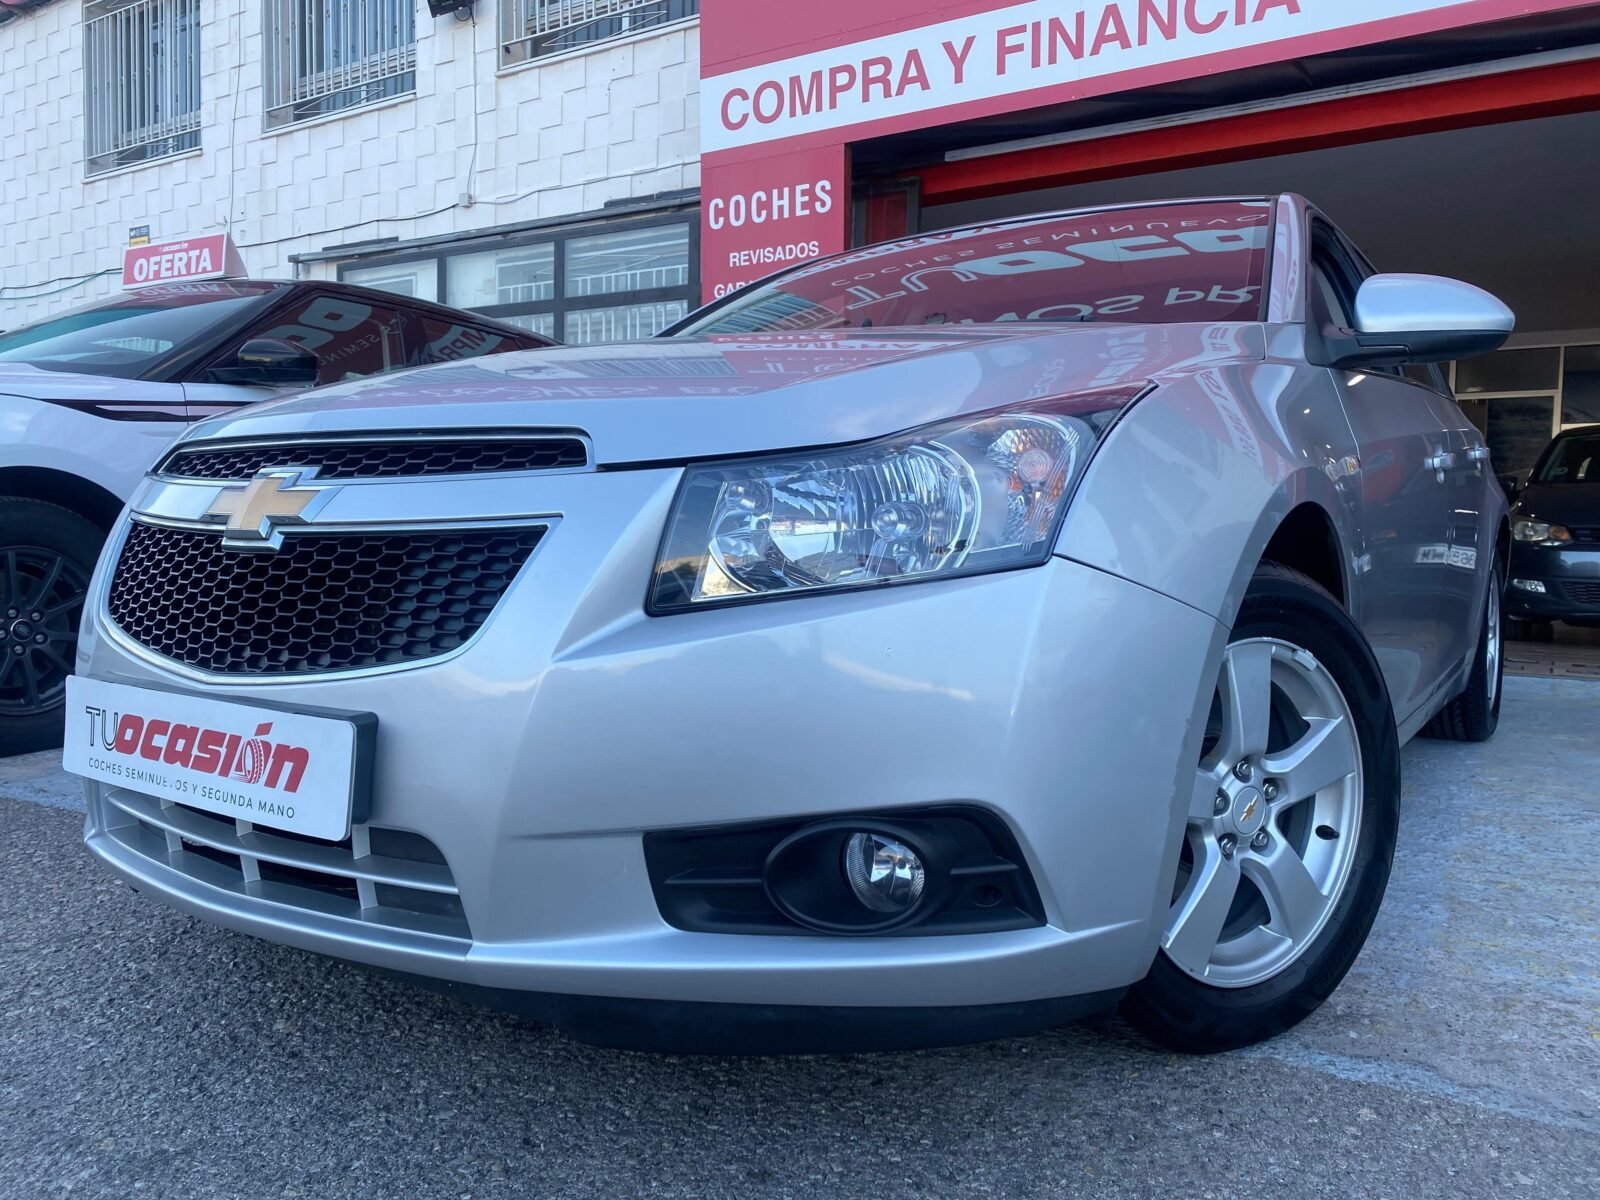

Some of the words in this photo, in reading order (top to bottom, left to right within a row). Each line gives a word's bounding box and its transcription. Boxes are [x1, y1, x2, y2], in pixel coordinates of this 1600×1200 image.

[721, 48, 931, 131] COMPRA
[941, 36, 976, 85] Y
[708, 179, 832, 230] COCHES
[133, 248, 212, 281] OFERTA
[729, 240, 820, 268] REVISADOS
[88, 757, 122, 776] COCHES
[125, 767, 188, 792] SEMINUEOS
[192, 783, 198, 795] Y
[201, 786, 253, 809] SEGUNDA
[258, 800, 295, 818] MANO
